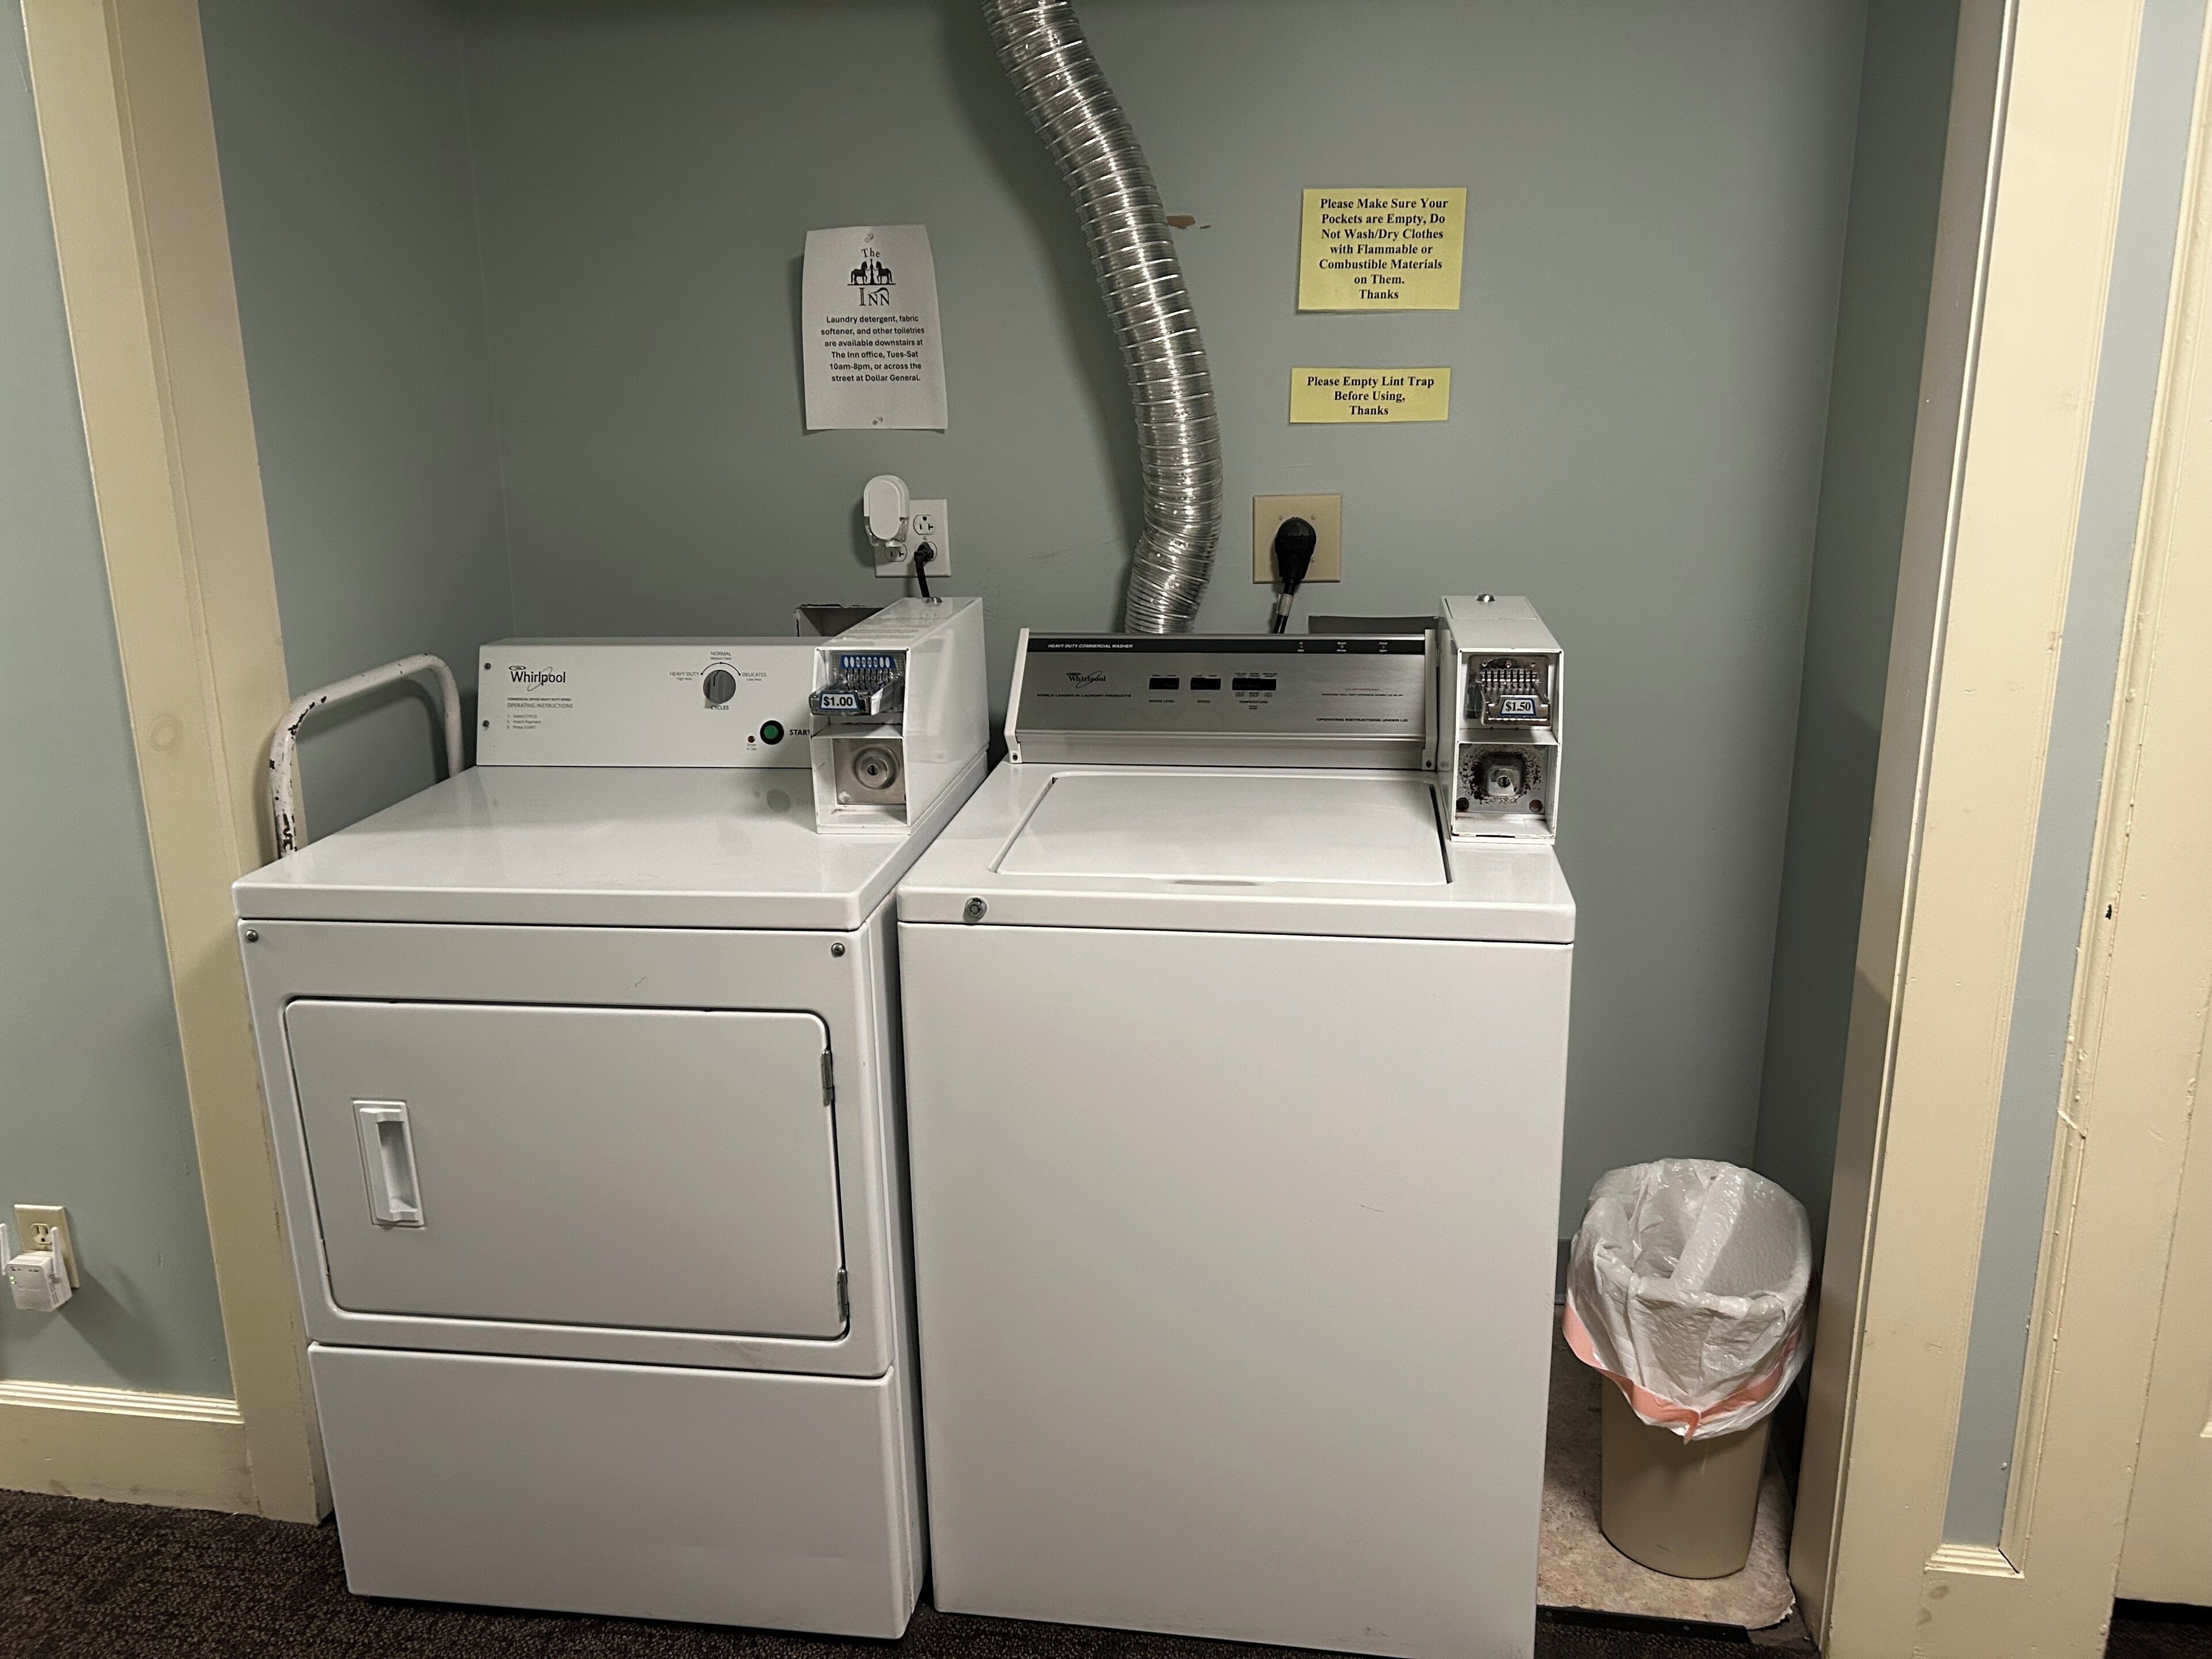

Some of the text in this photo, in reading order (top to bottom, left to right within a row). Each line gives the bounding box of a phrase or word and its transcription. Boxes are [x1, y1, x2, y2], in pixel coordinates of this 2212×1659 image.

[1320, 198, 1448, 209] Please Make Sure Your
[1321, 214, 1362, 224] Pockets
[1387, 214, 1426, 226] Empty,
[1430, 214, 1445, 224] Do
[1321, 229, 1444, 241] Not Wash/Dry Clothes
[861, 248, 880, 258] The
[1331, 244, 1353, 254] with
[1357, 244, 1418, 254] Flammable
[1319, 259, 1442, 269] Combustible Materials
[1370, 274, 1404, 284] Them.
[1359, 289, 1399, 299] Thanks
[827, 316, 857, 324] Laundry
[859, 315, 897, 323] detergent,
[821, 328, 855, 336] softener,
[830, 363, 872, 371] 10am-8pm,
[1307, 376, 1434, 388] Please Empty Lint Trap
[1334, 391, 1405, 403] Before Using,
[1349, 406, 1389, 415] Thanks
[510, 671, 566, 685] Whirlpool
[823, 696, 853, 707] $1.00
[1505, 701, 1531, 712] $1.50
